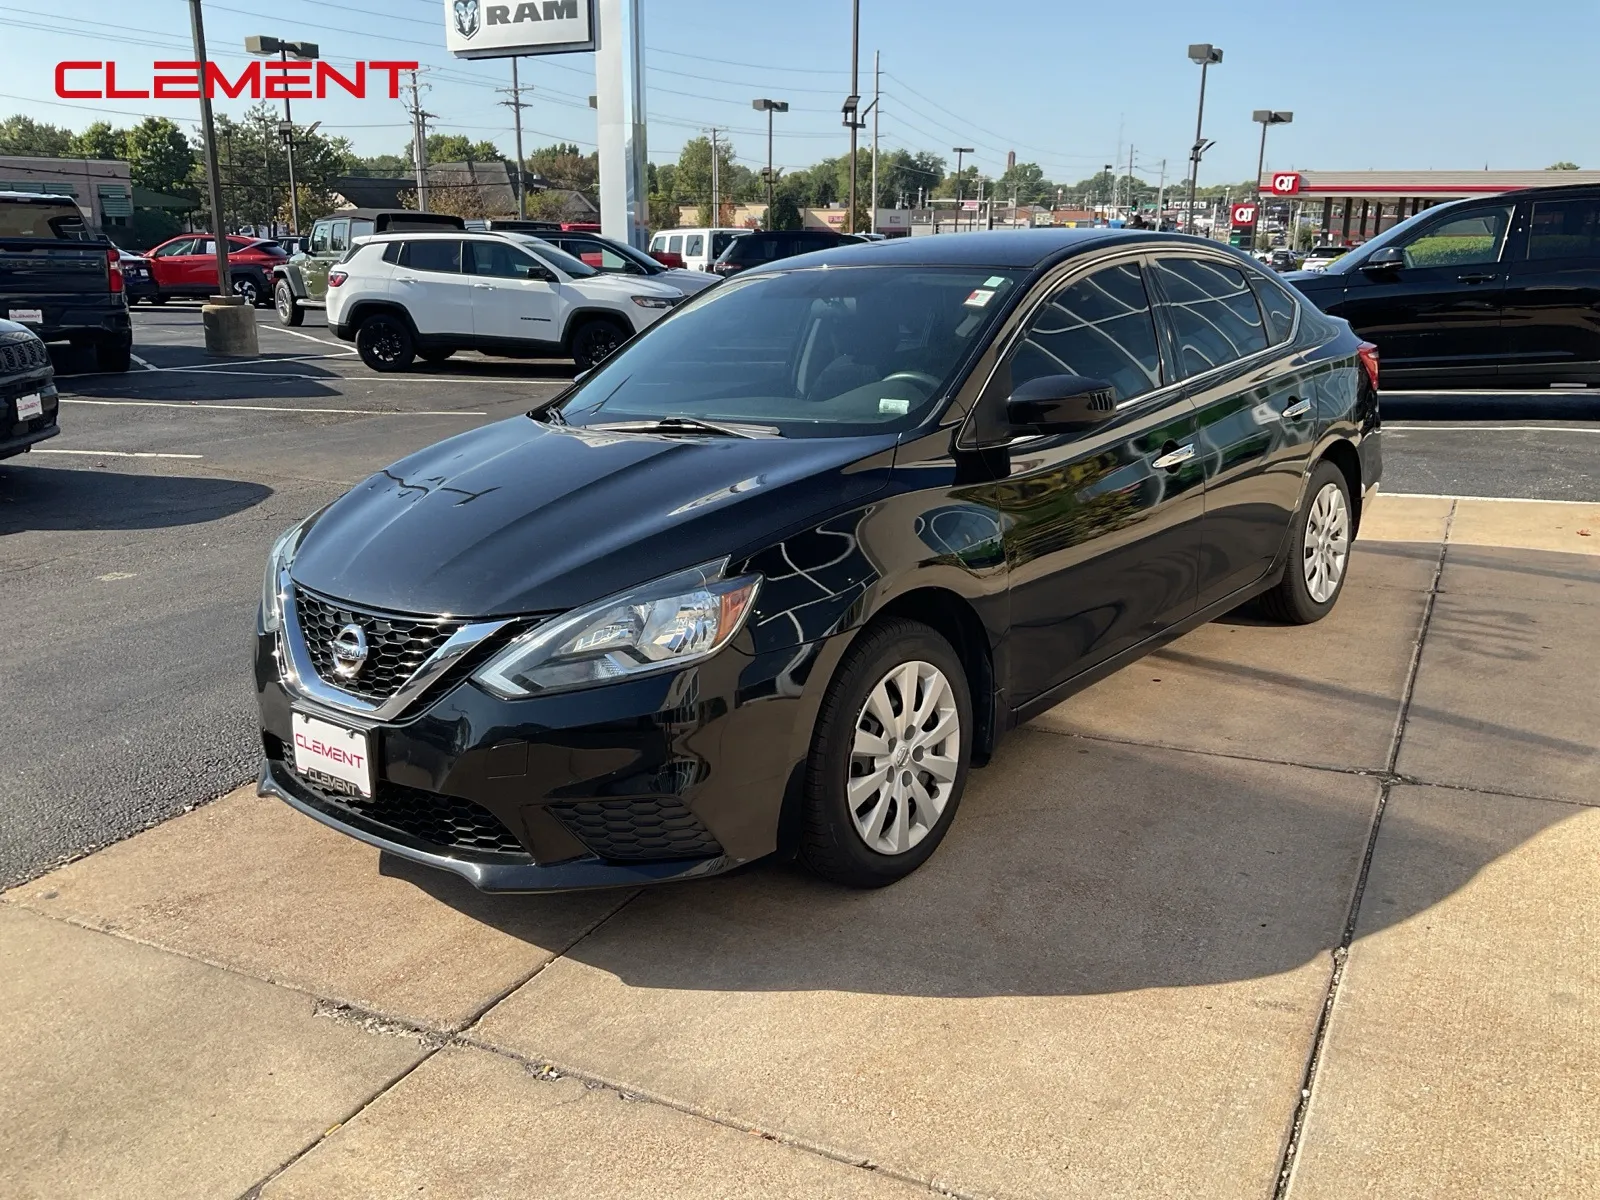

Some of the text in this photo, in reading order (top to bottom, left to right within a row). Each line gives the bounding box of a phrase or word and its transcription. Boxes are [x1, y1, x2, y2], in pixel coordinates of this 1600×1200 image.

[486, 1, 578, 26] RAM
[1275, 175, 1296, 192] QT
[1235, 207, 1255, 223] QT
[295, 733, 364, 769] CLEMENT
[308, 769, 357, 795] CLEMENT
